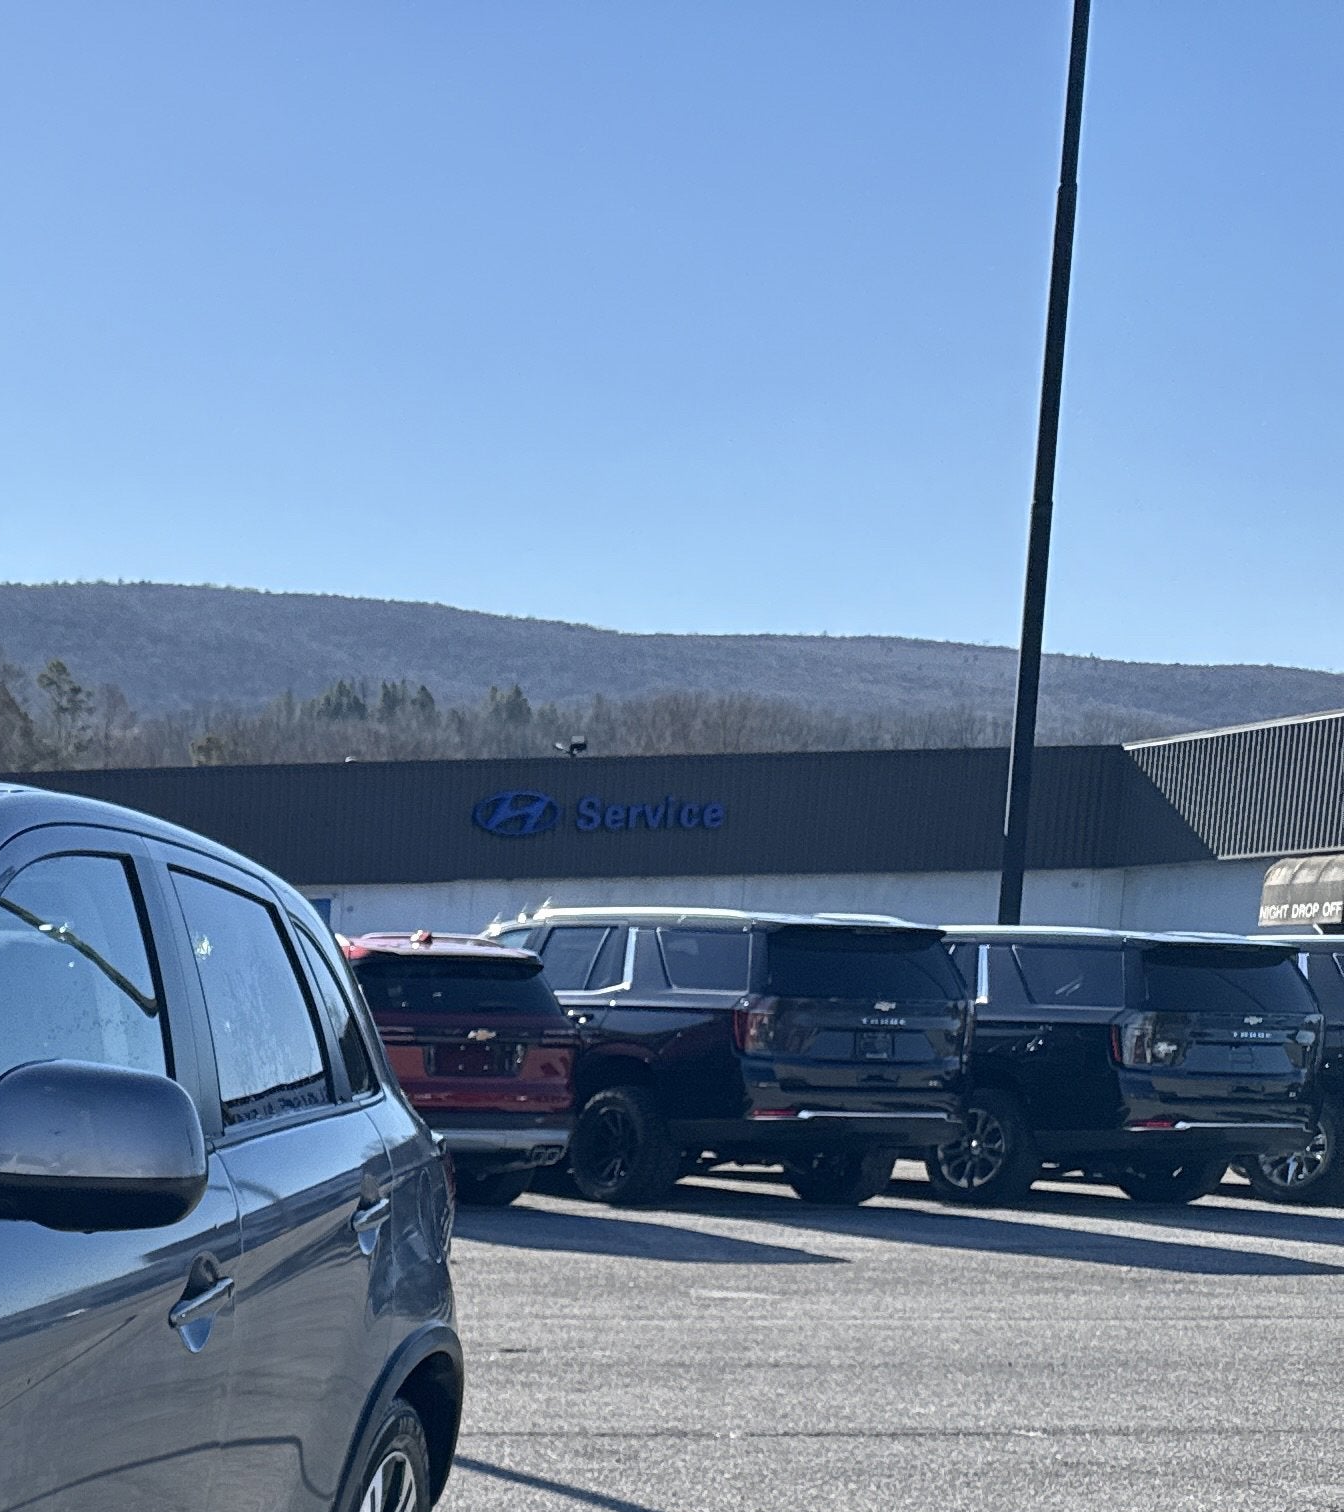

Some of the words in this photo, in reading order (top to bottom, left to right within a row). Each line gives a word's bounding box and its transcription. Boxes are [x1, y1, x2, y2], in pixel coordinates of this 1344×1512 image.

[575, 795, 725, 831] Service
[1259, 904, 1290, 920] NIGHT
[1291, 902, 1320, 919] DROP
[1322, 900, 1344, 918] OFF
